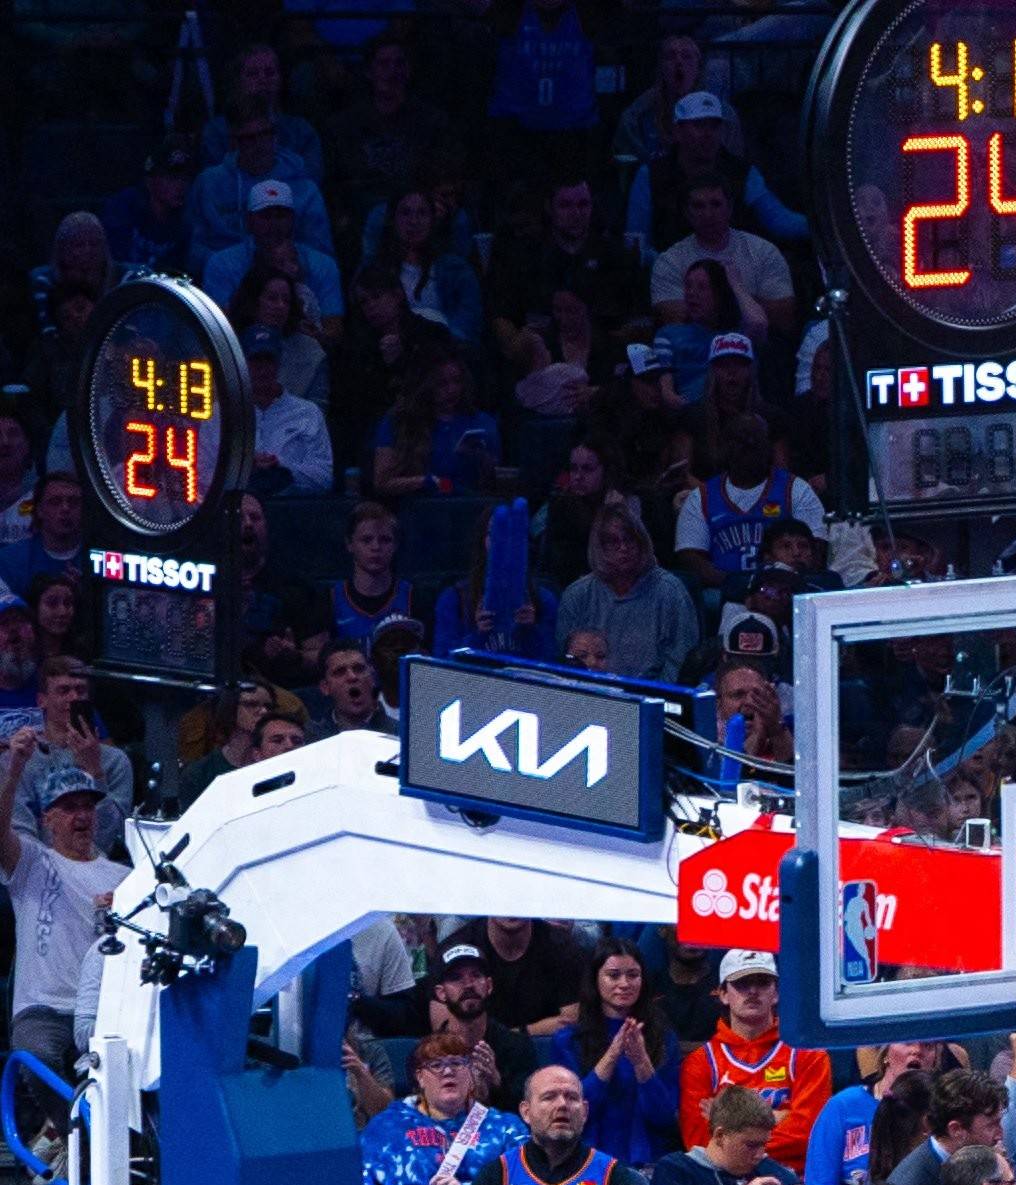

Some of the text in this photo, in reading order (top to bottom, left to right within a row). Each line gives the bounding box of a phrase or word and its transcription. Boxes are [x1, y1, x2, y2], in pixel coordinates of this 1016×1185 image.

[131, 358, 212, 420] 4:13
[126, 422, 197, 503] 24
[123, 554, 216, 592] TISSOT
